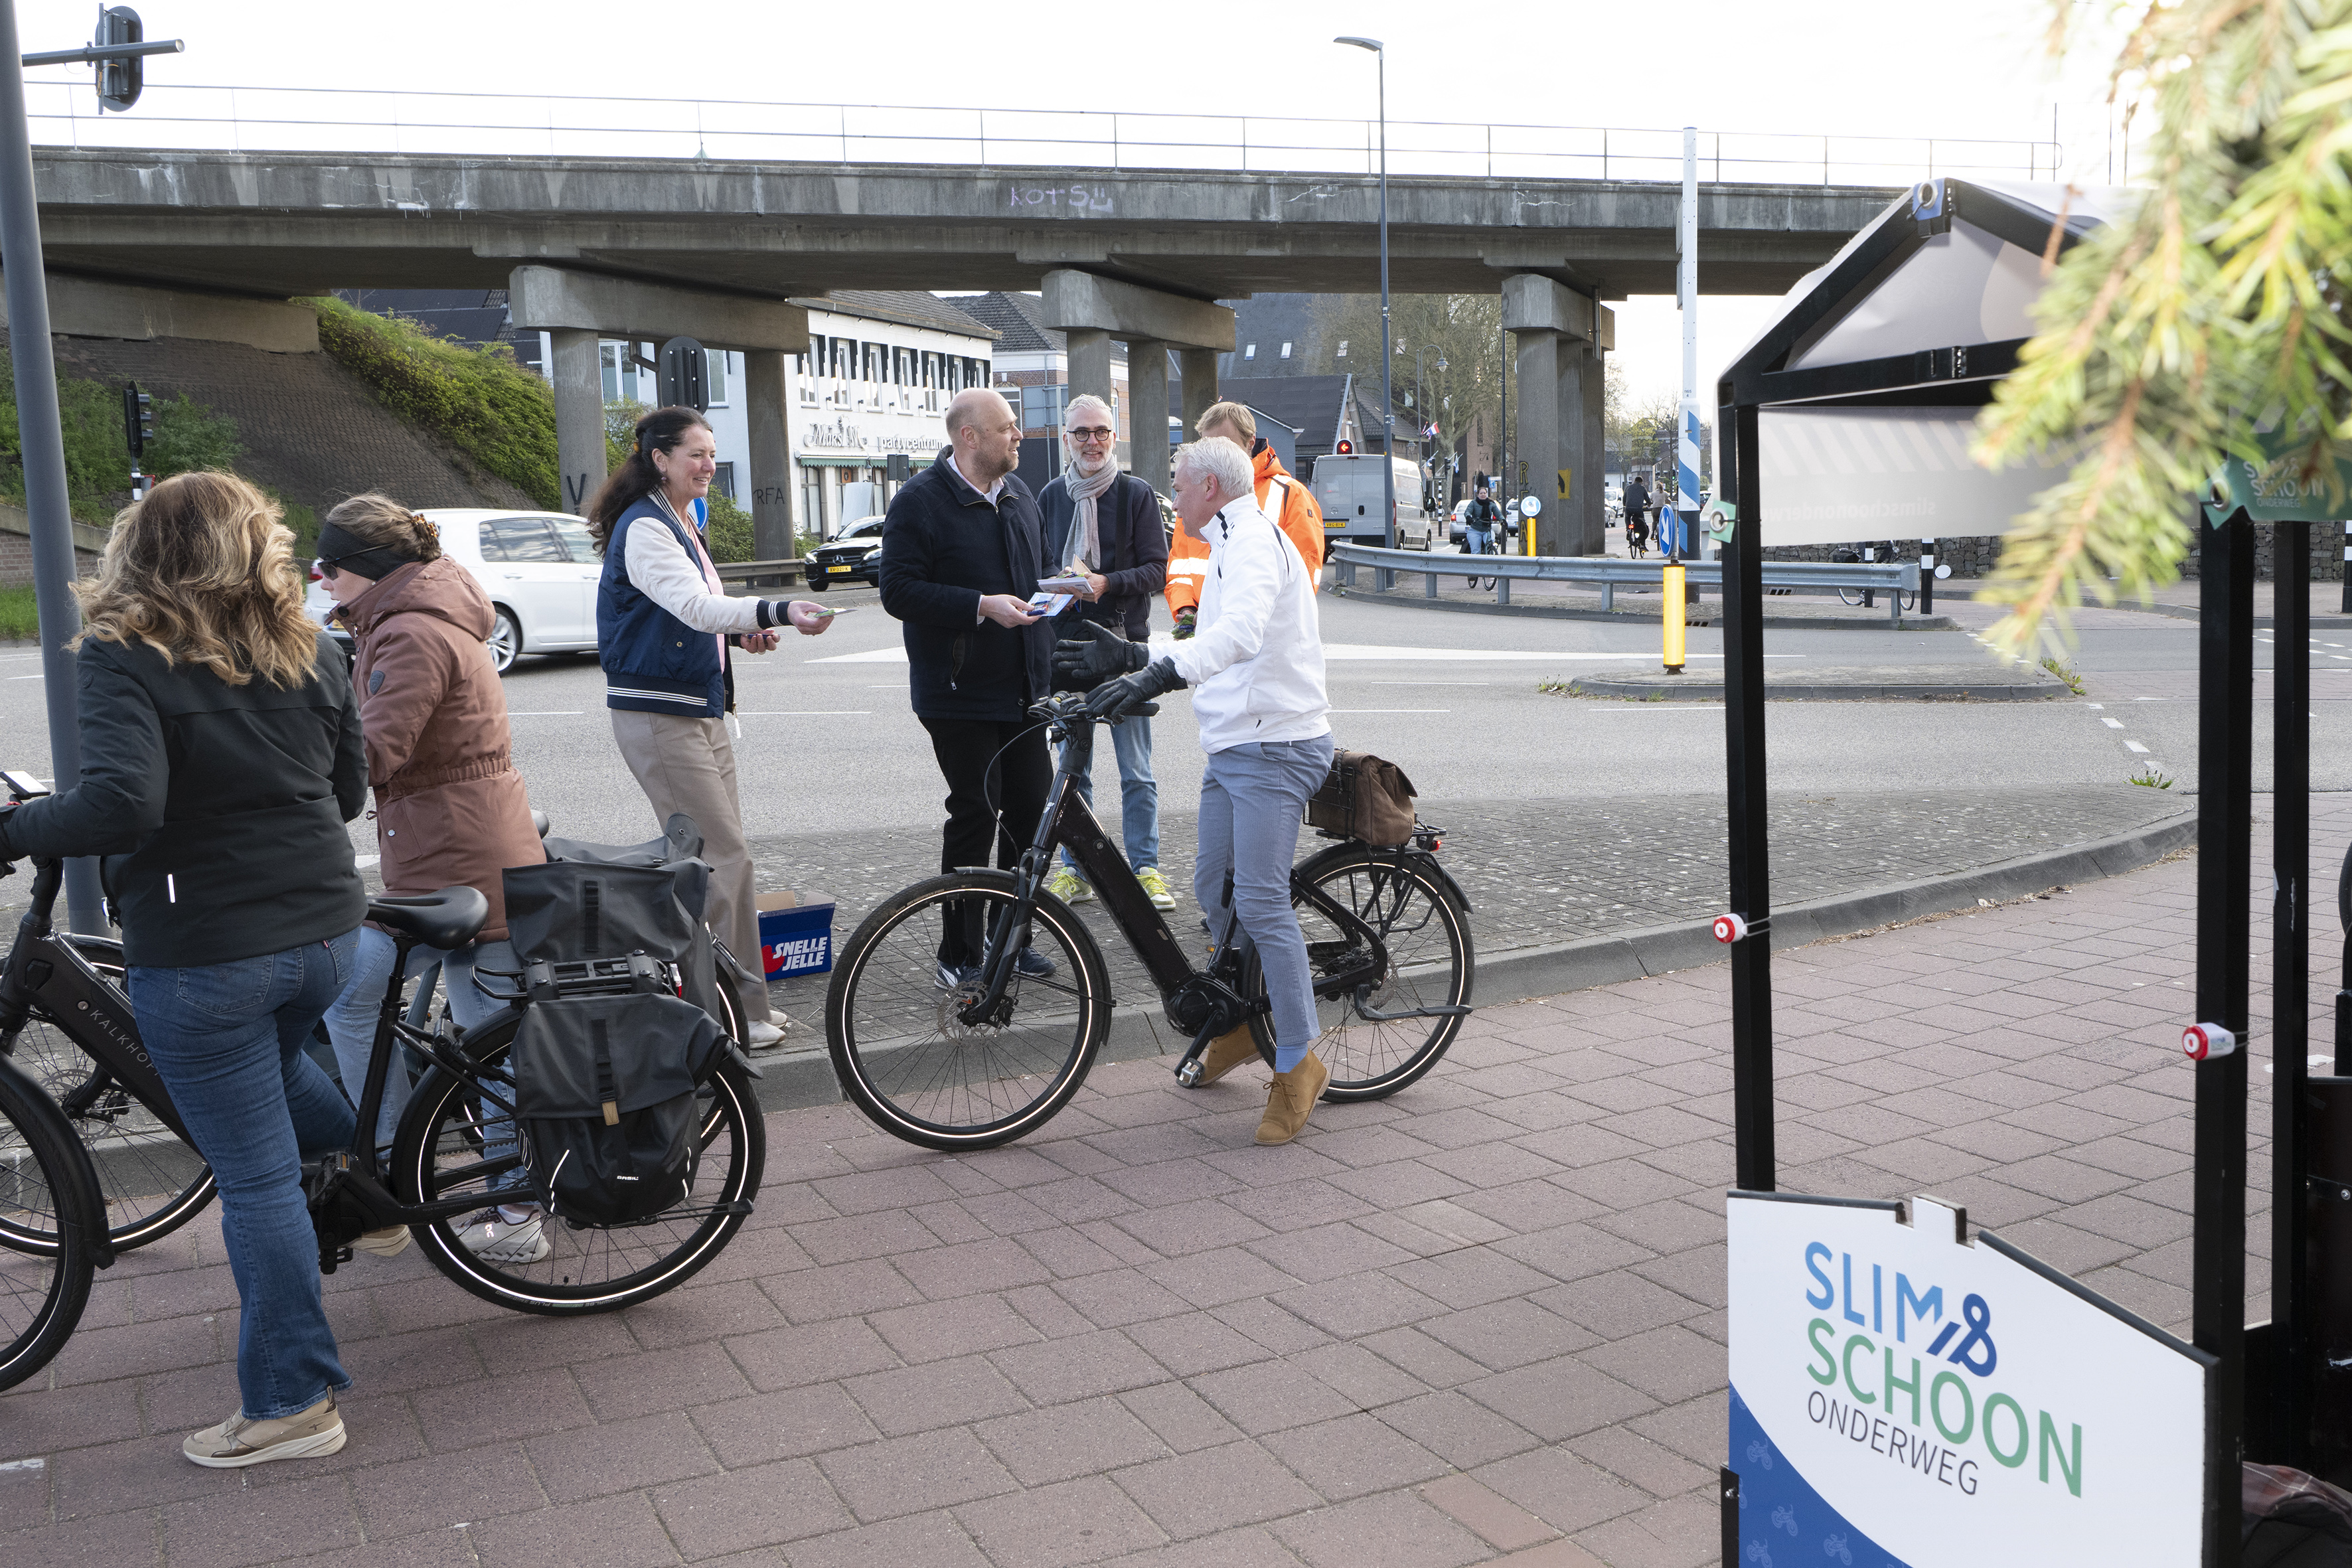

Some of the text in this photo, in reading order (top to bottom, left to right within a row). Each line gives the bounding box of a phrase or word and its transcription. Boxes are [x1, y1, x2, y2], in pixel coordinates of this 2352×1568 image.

[879, 435, 943, 452] partycentrum
[753, 487, 785, 505] RFA
[773, 936, 828, 959] SNELLE
[781, 951, 824, 971] JELLE
[90, 1010, 159, 1075] KALKHOF
[1806, 1318, 2082, 1498] SCHOON
[1808, 1391, 1979, 1496] ONDERWEG
